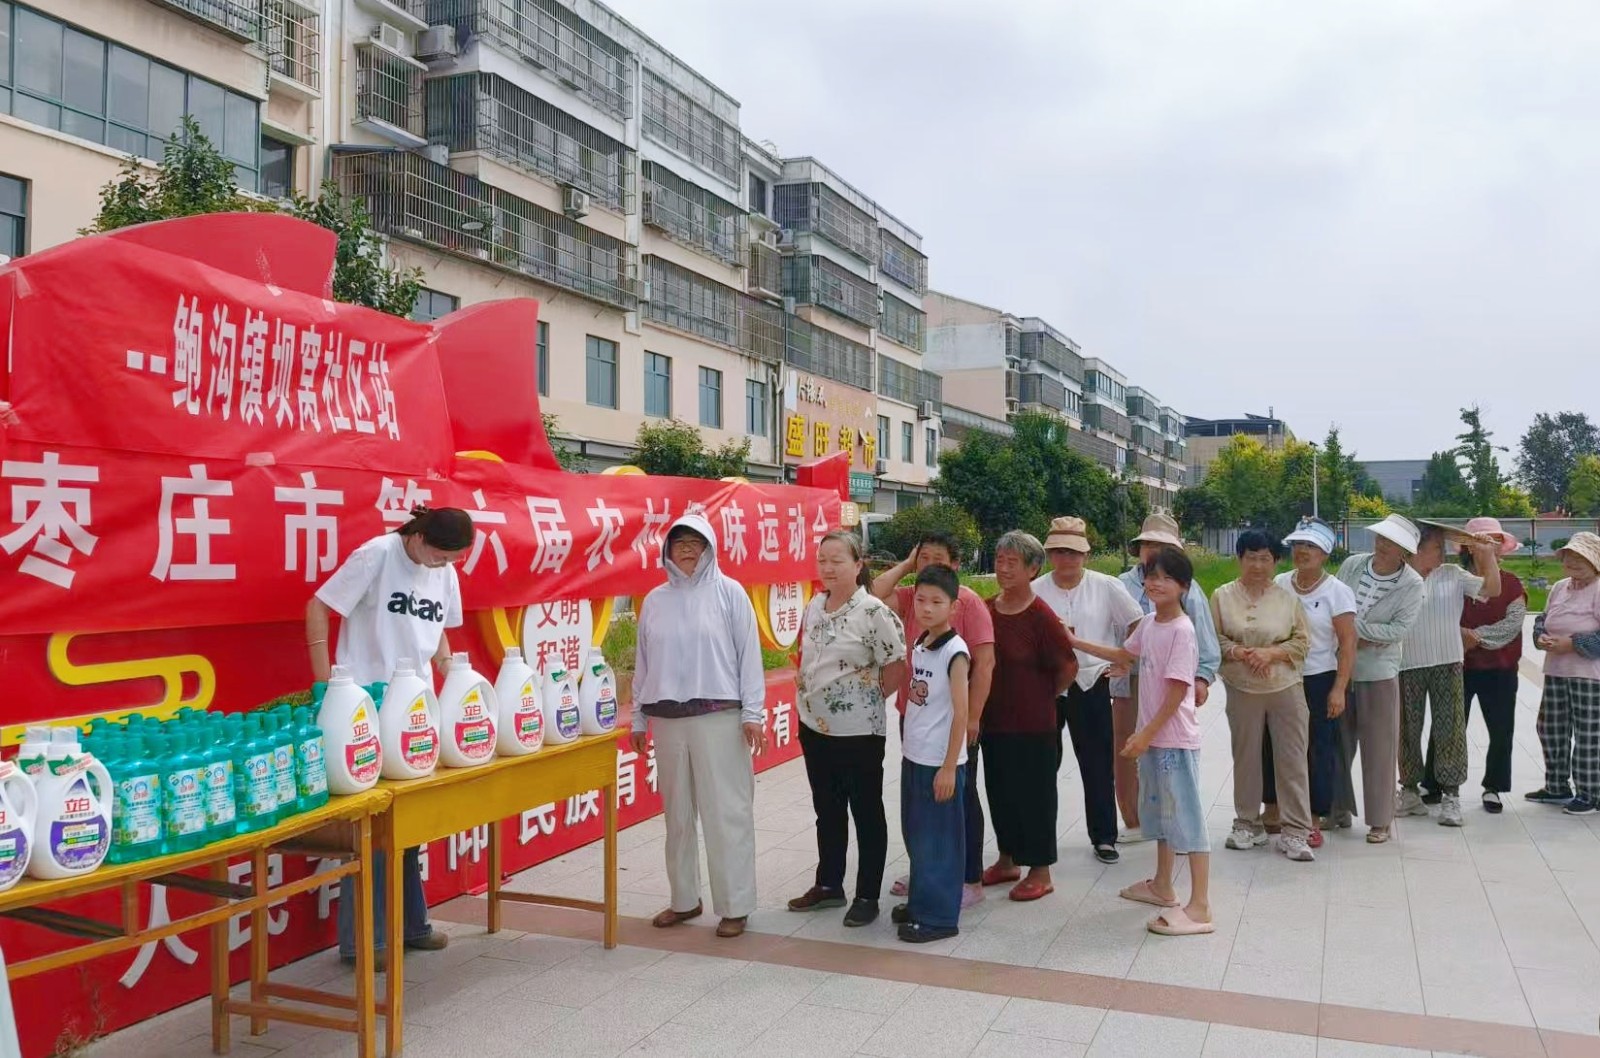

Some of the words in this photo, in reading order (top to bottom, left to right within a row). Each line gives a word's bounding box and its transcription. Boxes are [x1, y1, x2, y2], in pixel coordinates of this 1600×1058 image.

[776, 606, 798, 632] 友善
[536, 635, 580, 676] 和谐
[464, 705, 481, 717] 立白
[410, 713, 427, 726] 立白
[353, 723, 369, 737] 立白
[64, 798, 90, 813] 立白
